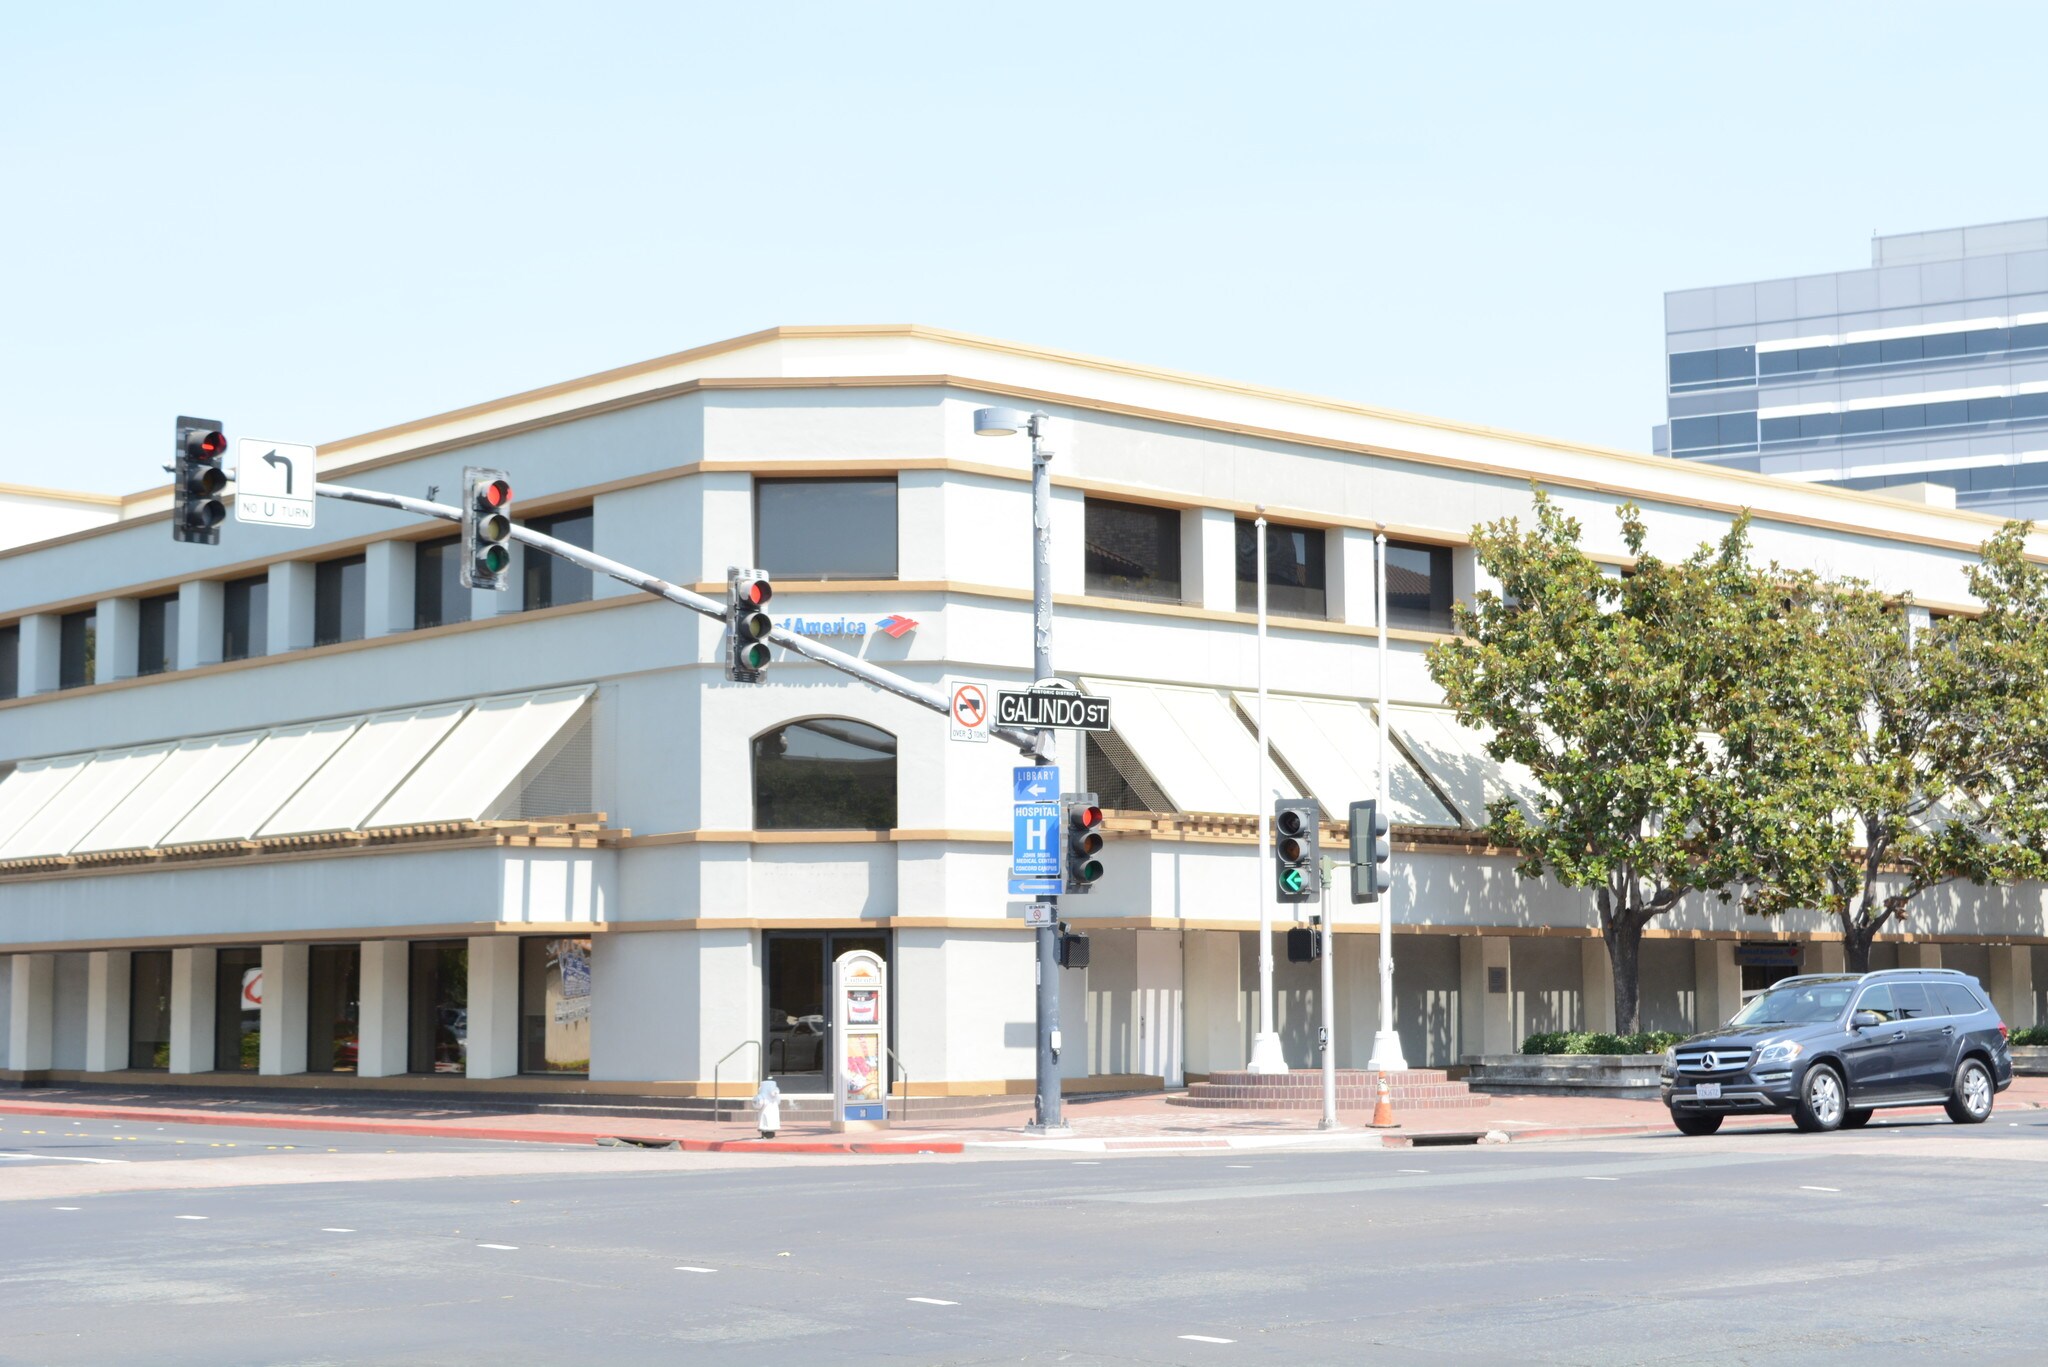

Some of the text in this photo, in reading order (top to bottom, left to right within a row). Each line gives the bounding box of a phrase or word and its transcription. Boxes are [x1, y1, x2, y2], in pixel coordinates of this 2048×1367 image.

[243, 502, 309, 518] NO U TURN
[793, 617, 866, 635] America
[1001, 696, 1107, 725] GALINDO ST
[953, 729, 966, 737] OVER
[967, 728, 973, 739] 3
[1018, 771, 1054, 781] LIBRARY
[1015, 807, 1058, 817] HOSPITAL
[1026, 819, 1047, 850] H
